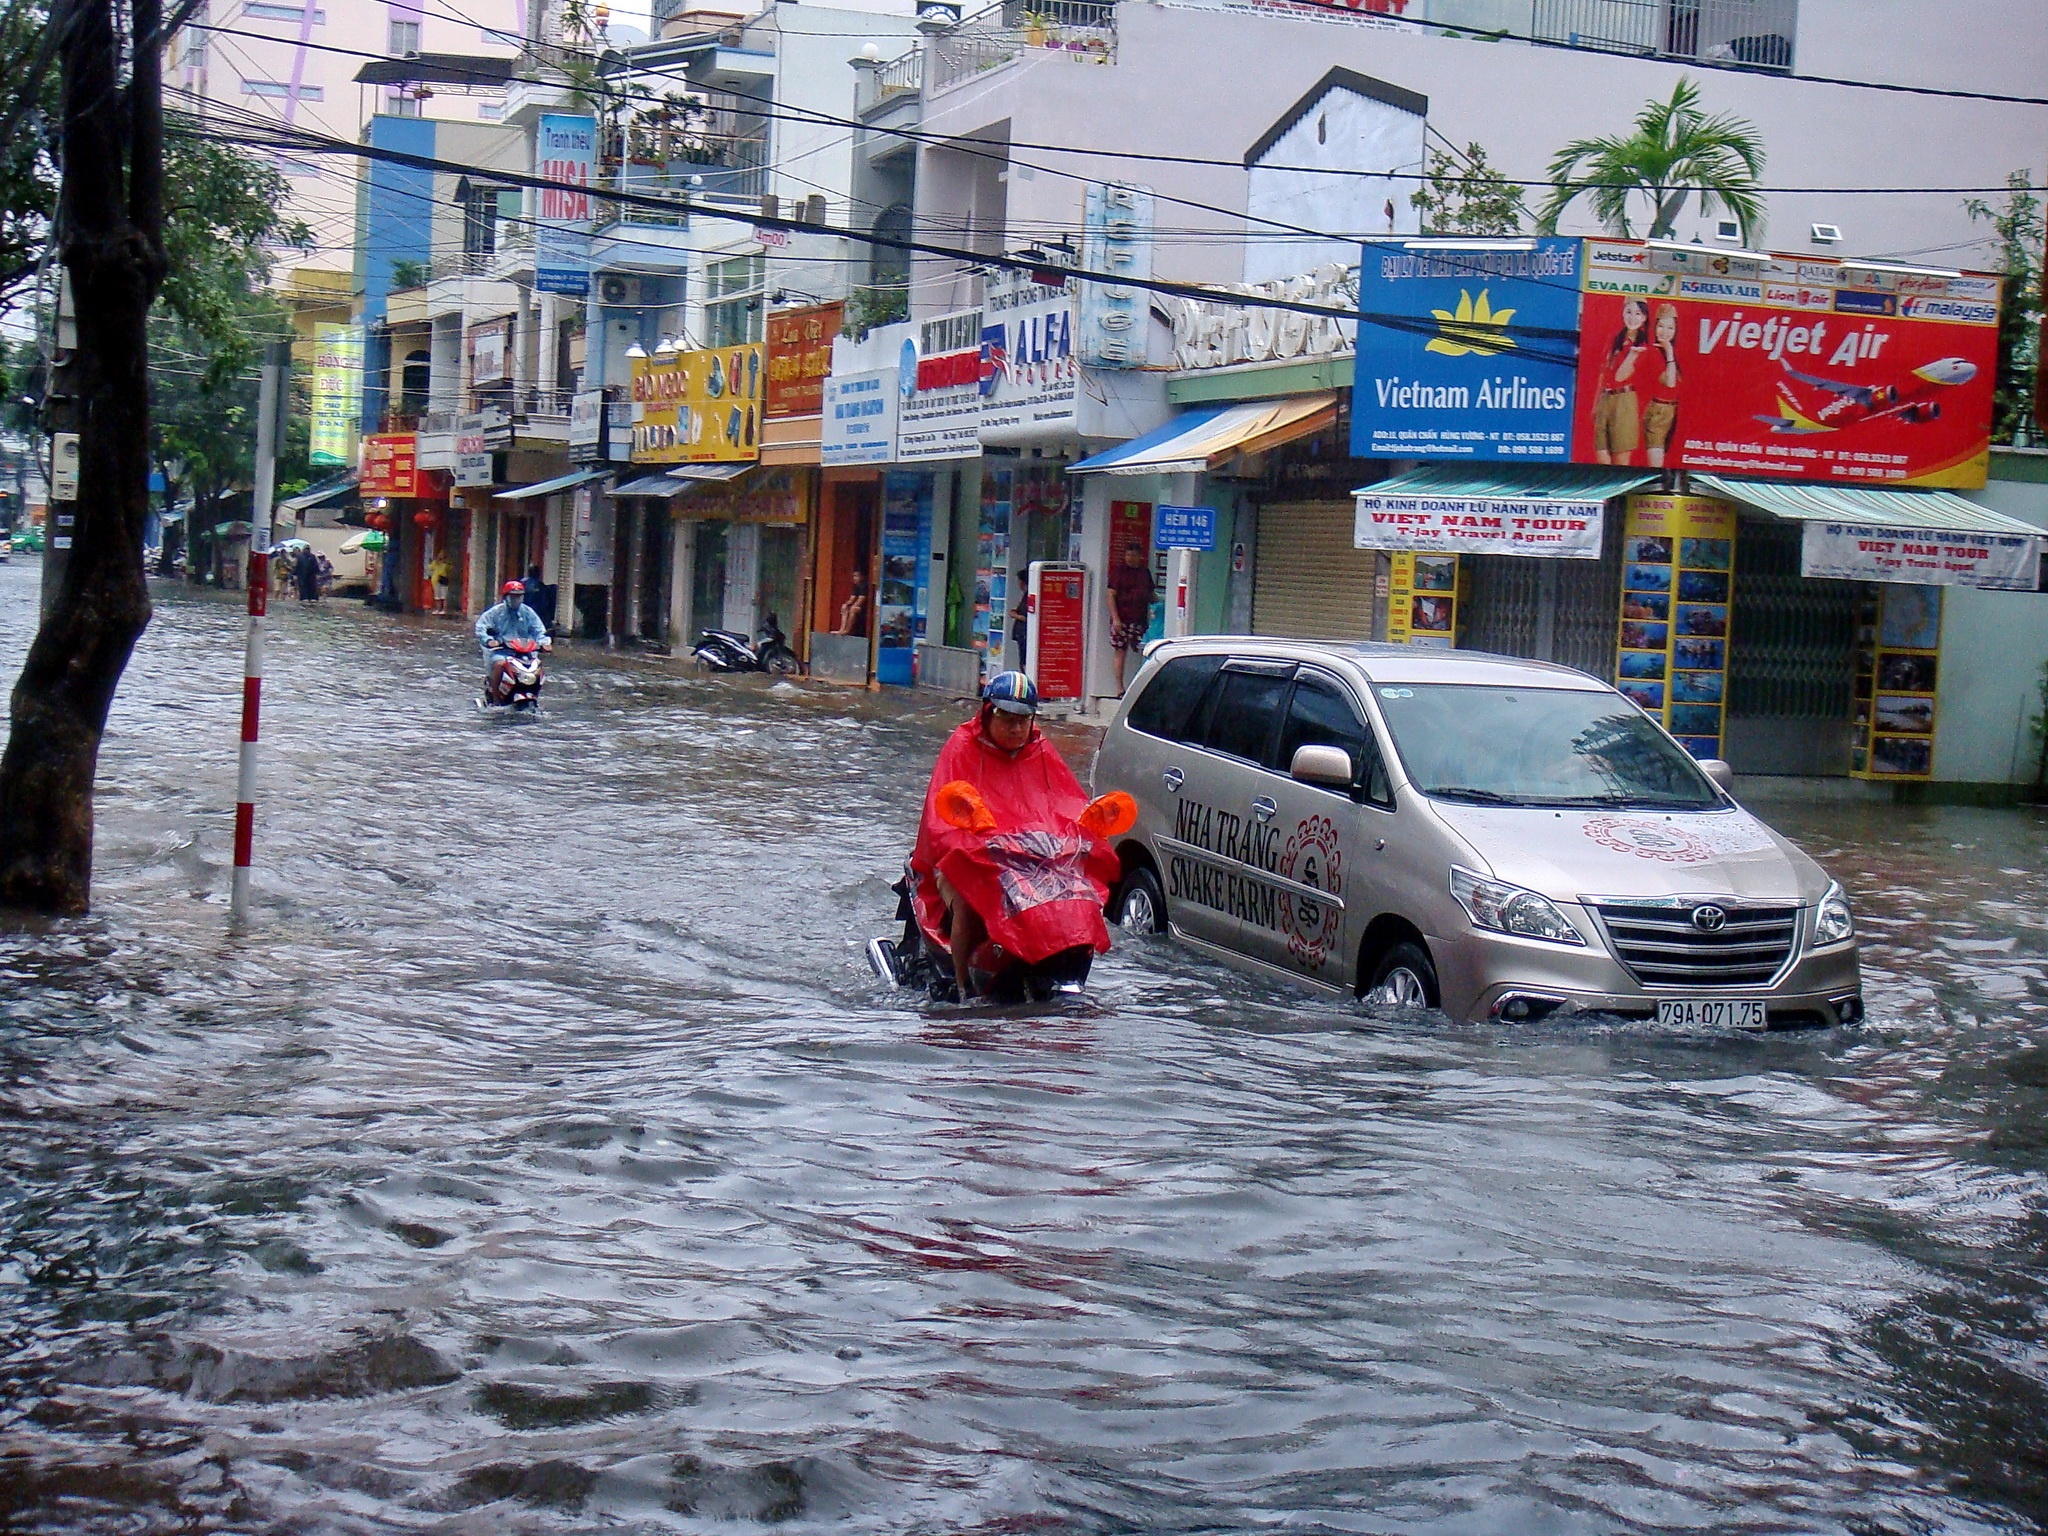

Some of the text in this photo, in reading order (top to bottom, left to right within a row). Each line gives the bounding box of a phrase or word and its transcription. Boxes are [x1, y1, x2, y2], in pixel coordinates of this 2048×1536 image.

[543, 159, 588, 219] MISA
[1593, 250, 1634, 264] Jetstar
[1800, 264, 1835, 279] QATAR
[1588, 280, 1648, 294] EVA AIR
[1681, 281, 1761, 298] KOREAN AIR
[1767, 288, 1795, 302] Lion
[1924, 301, 1997, 322] malaysia
[1015, 310, 1071, 366] ALFA
[1698, 312, 1890, 368] Vietjet Air
[1375, 376, 1566, 410] Vietnam Airlines
[1364, 498, 1381, 509] HỘ
[1386, 499, 1416, 511] KINH
[1421, 501, 1464, 513] DOANH
[1492, 500, 1528, 515] HÀNH
[1532, 503, 1563, 517] VIỆT
[1567, 505, 1597, 517] NAM
[1371, 513, 1587, 531] VIET NAM TOUR
[1397, 527, 1562, 543] T-jay Travel Agent
[1858, 540, 1989, 560] VIET NAM TOUR
[1944, 561, 1975, 572] Agent
[1174, 798, 1281, 874] NHA TRANG
[1170, 857, 1276, 931] SNAKE FARM
[1661, 1002, 1764, 1026] 79A-071.75
